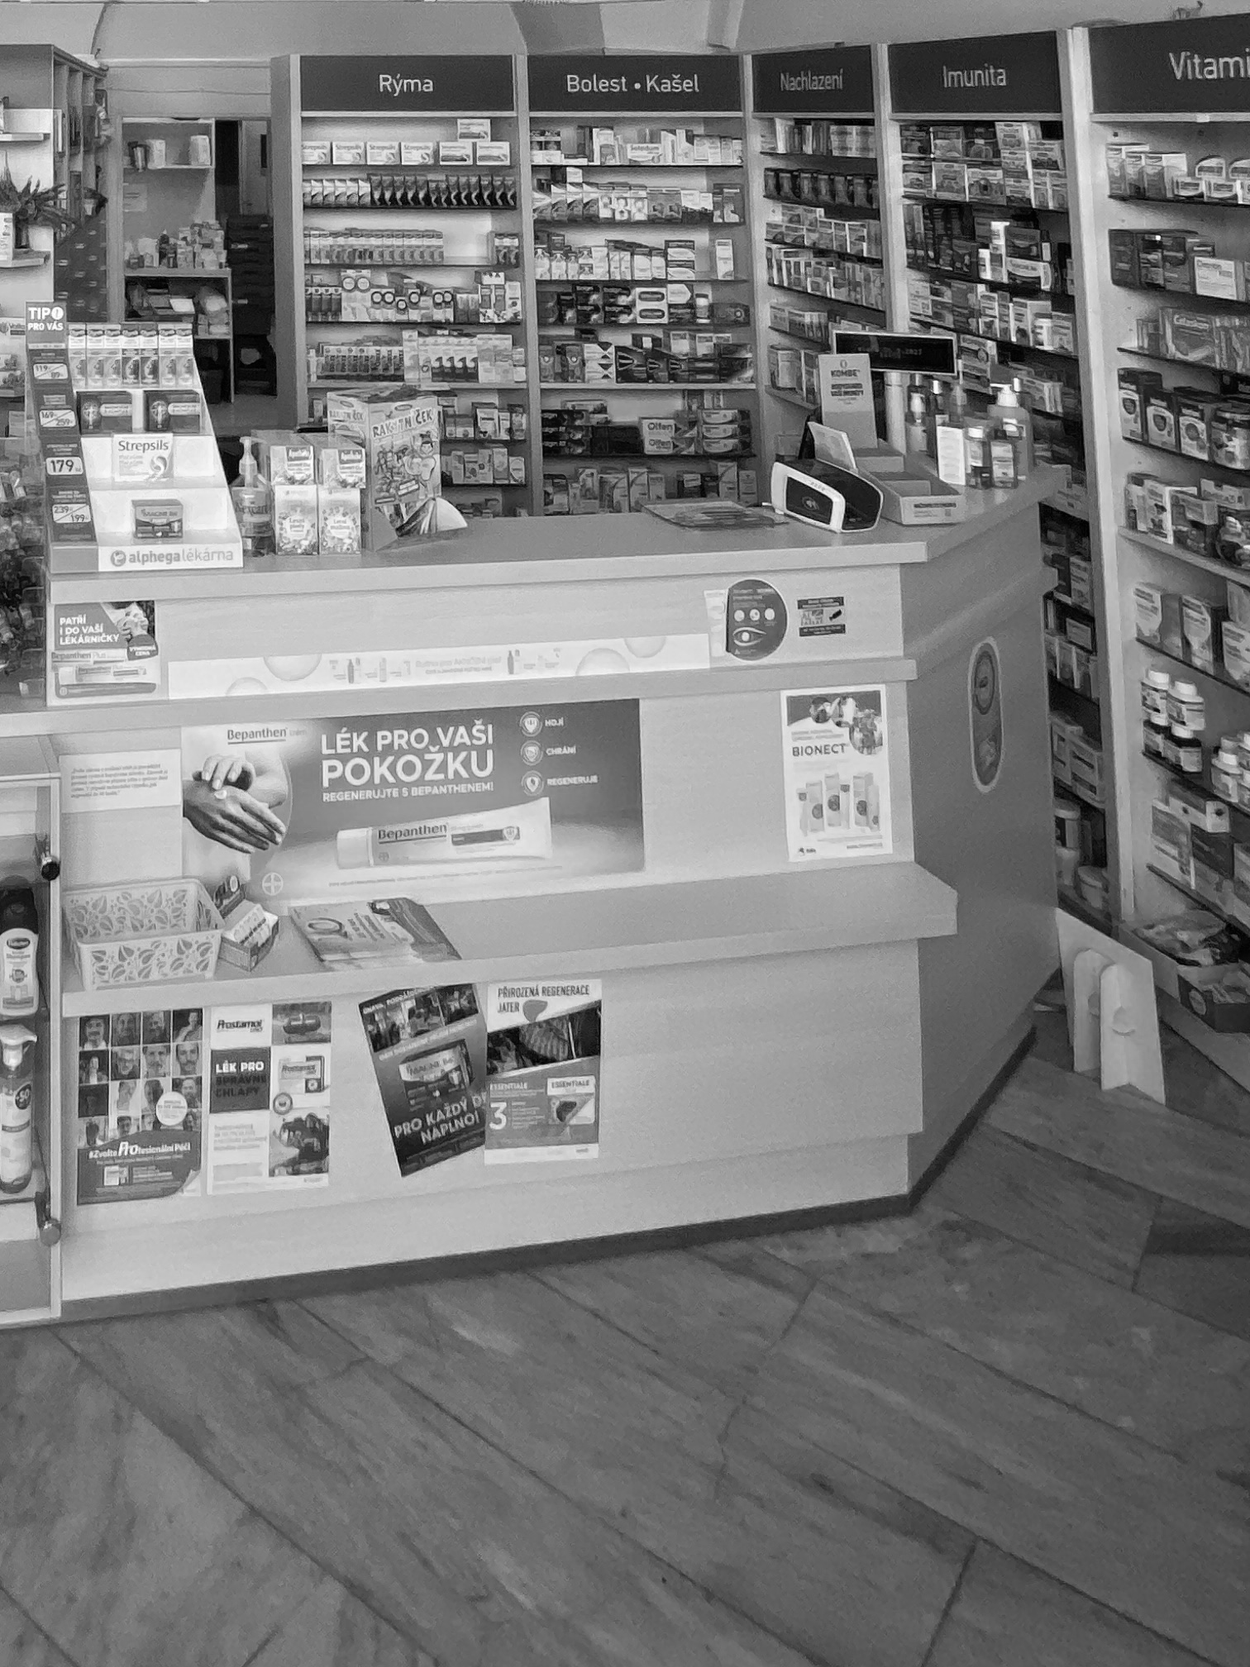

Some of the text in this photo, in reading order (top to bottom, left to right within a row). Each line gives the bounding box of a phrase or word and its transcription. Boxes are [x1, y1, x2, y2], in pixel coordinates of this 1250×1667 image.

[780, 68, 843, 92] Nachlazení
[943, 63, 1007, 89] Imunita
[379, 73, 434, 97] Rýma
[566, 74, 700, 93] Bolest Kašel
[28, 322, 44, 331] PRO
[46, 321, 64, 331] VÁS
[118, 439, 169, 454] Strepsils
[50, 459, 74, 473] 179
[54, 506, 70, 514] 239
[70, 514, 86, 522] 199
[128, 548, 234, 565] alphega lékárna
[59, 614, 86, 626] PATŘÍ
[65, 626, 80, 635] DO
[82, 622, 104, 634] VAŠÍ
[60, 633, 120, 646] LÉKÁRNIČKY
[544, 717, 564, 728] HOJÍ
[227, 727, 288, 742] Bepanthen
[321, 718, 493, 754] LÉK PRO VAŠI
[546, 745, 576, 756] CHRÁNÍ
[792, 742, 846, 756] BIONECT
[322, 745, 494, 788] POKOŽKU
[546, 775, 598, 786] REGENERUJE
[322, 782, 494, 802] REGENERUJTE S BEPANTHENEM!
[378, 824, 448, 840] Bepanthen
[498, 984, 590, 998] PŘIROZENÁ REGENERACE
[498, 1002, 520, 1013] JATER
[216, 1060, 264, 1074] LÉK PRO
[551, 1080, 590, 1089] ESSENTIALE
[394, 1118, 422, 1138] PRO
[426, 1096, 468, 1126] KAŽDÝ
[489, 1102, 507, 1130] 3
